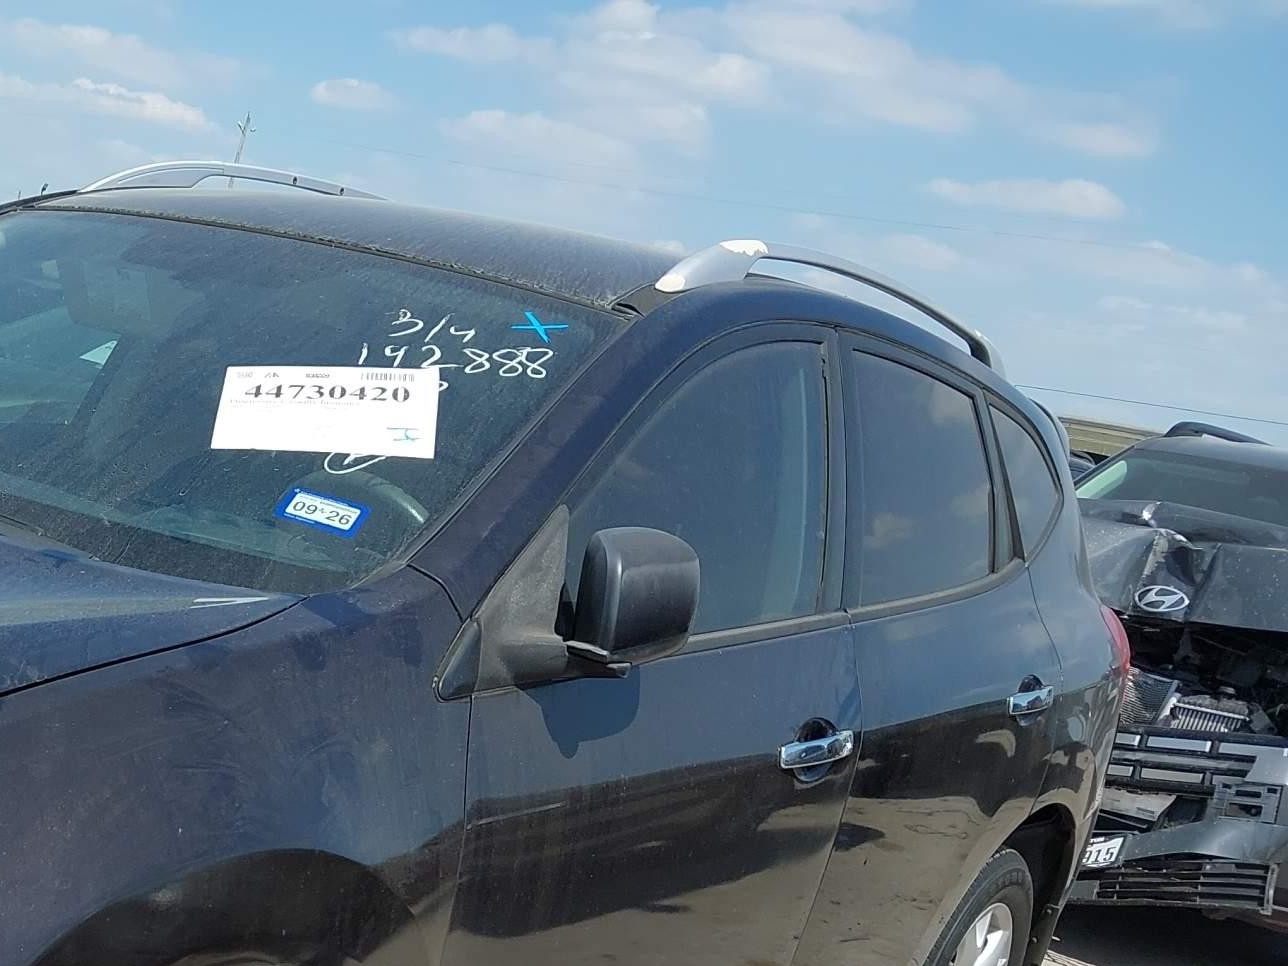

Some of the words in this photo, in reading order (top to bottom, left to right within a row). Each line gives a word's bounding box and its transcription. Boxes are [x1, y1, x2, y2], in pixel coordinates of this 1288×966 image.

[386, 308, 476, 343] 3/4
[244, 383, 410, 403] 44730420
[292, 500, 318, 515] 09
[325, 510, 353, 526] 26
